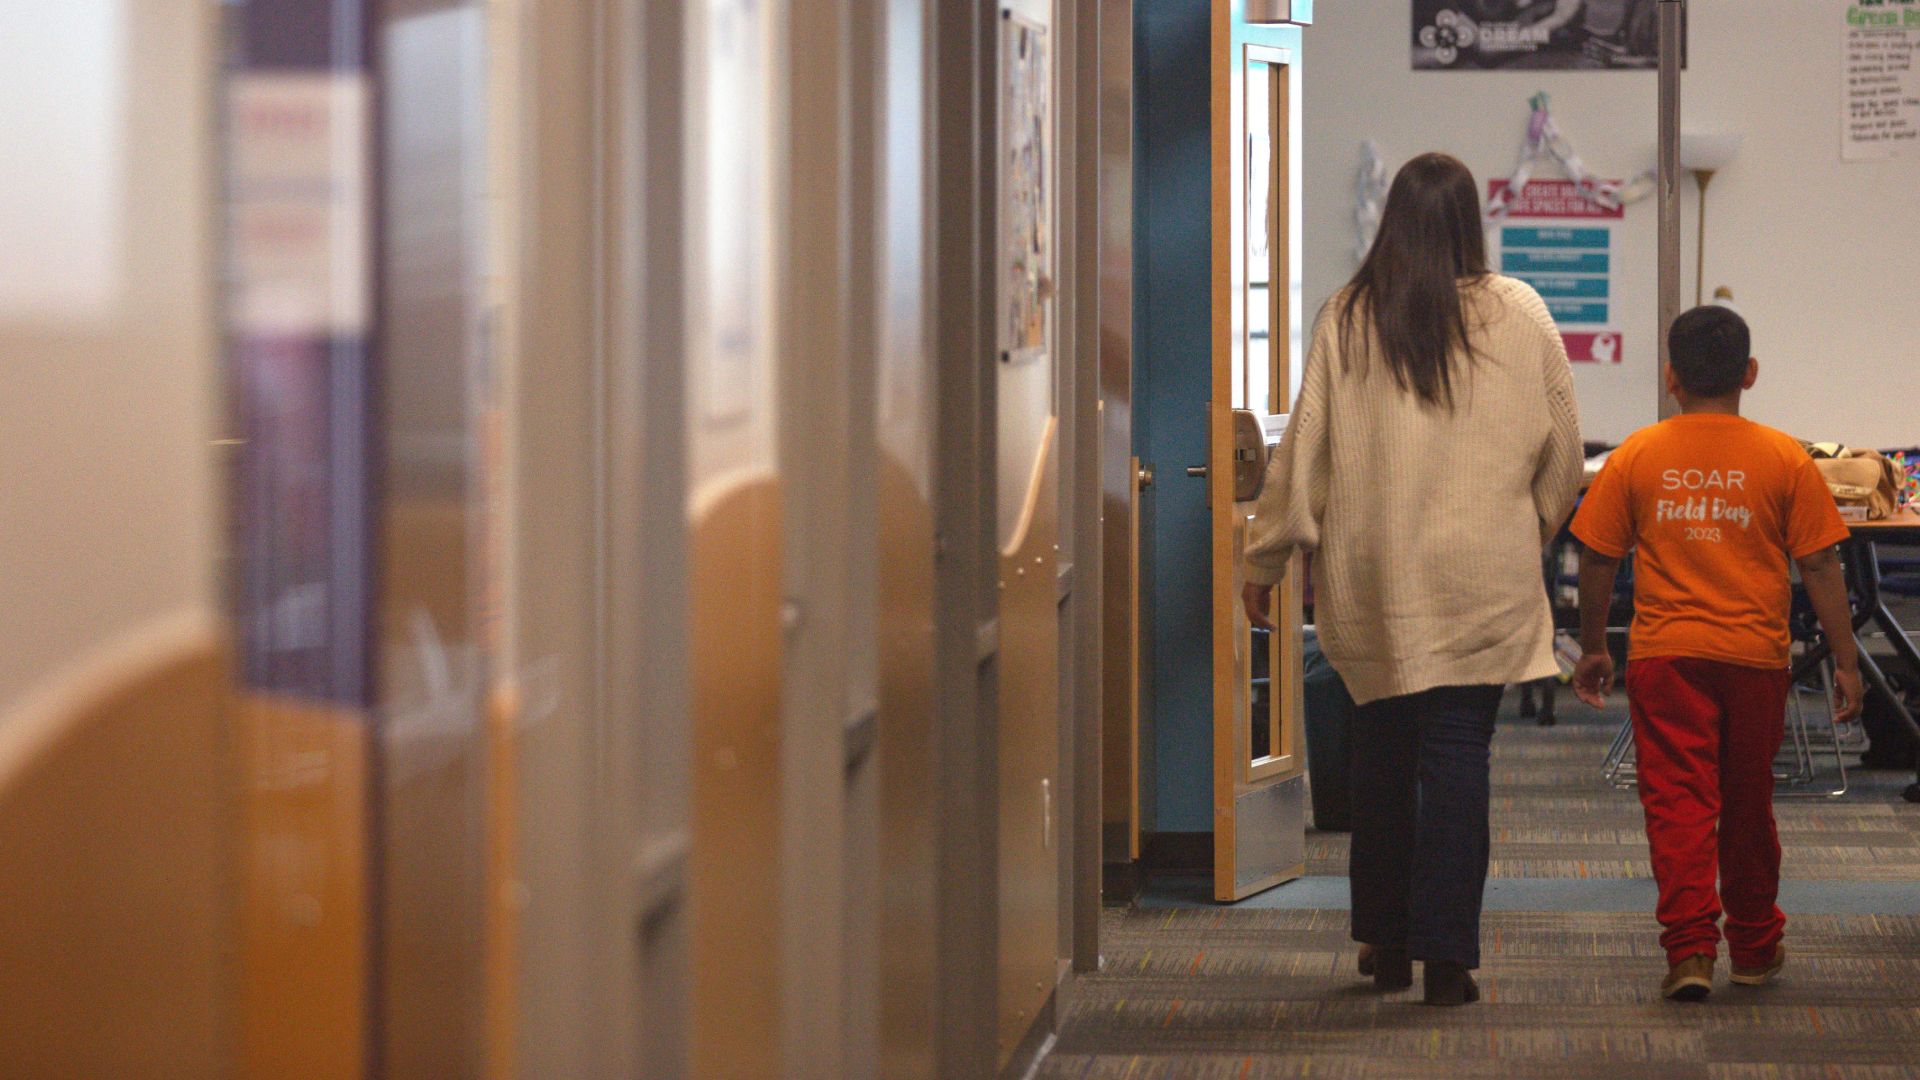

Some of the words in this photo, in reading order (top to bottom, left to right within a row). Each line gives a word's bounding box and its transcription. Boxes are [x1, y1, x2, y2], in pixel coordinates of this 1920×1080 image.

[1479, 29, 1549, 42] DREAM
[1662, 468, 1745, 490] SOAR
[1656, 496, 1707, 526] Field
[1712, 497, 1753, 528] Day
[1684, 527, 1721, 543] 2023
